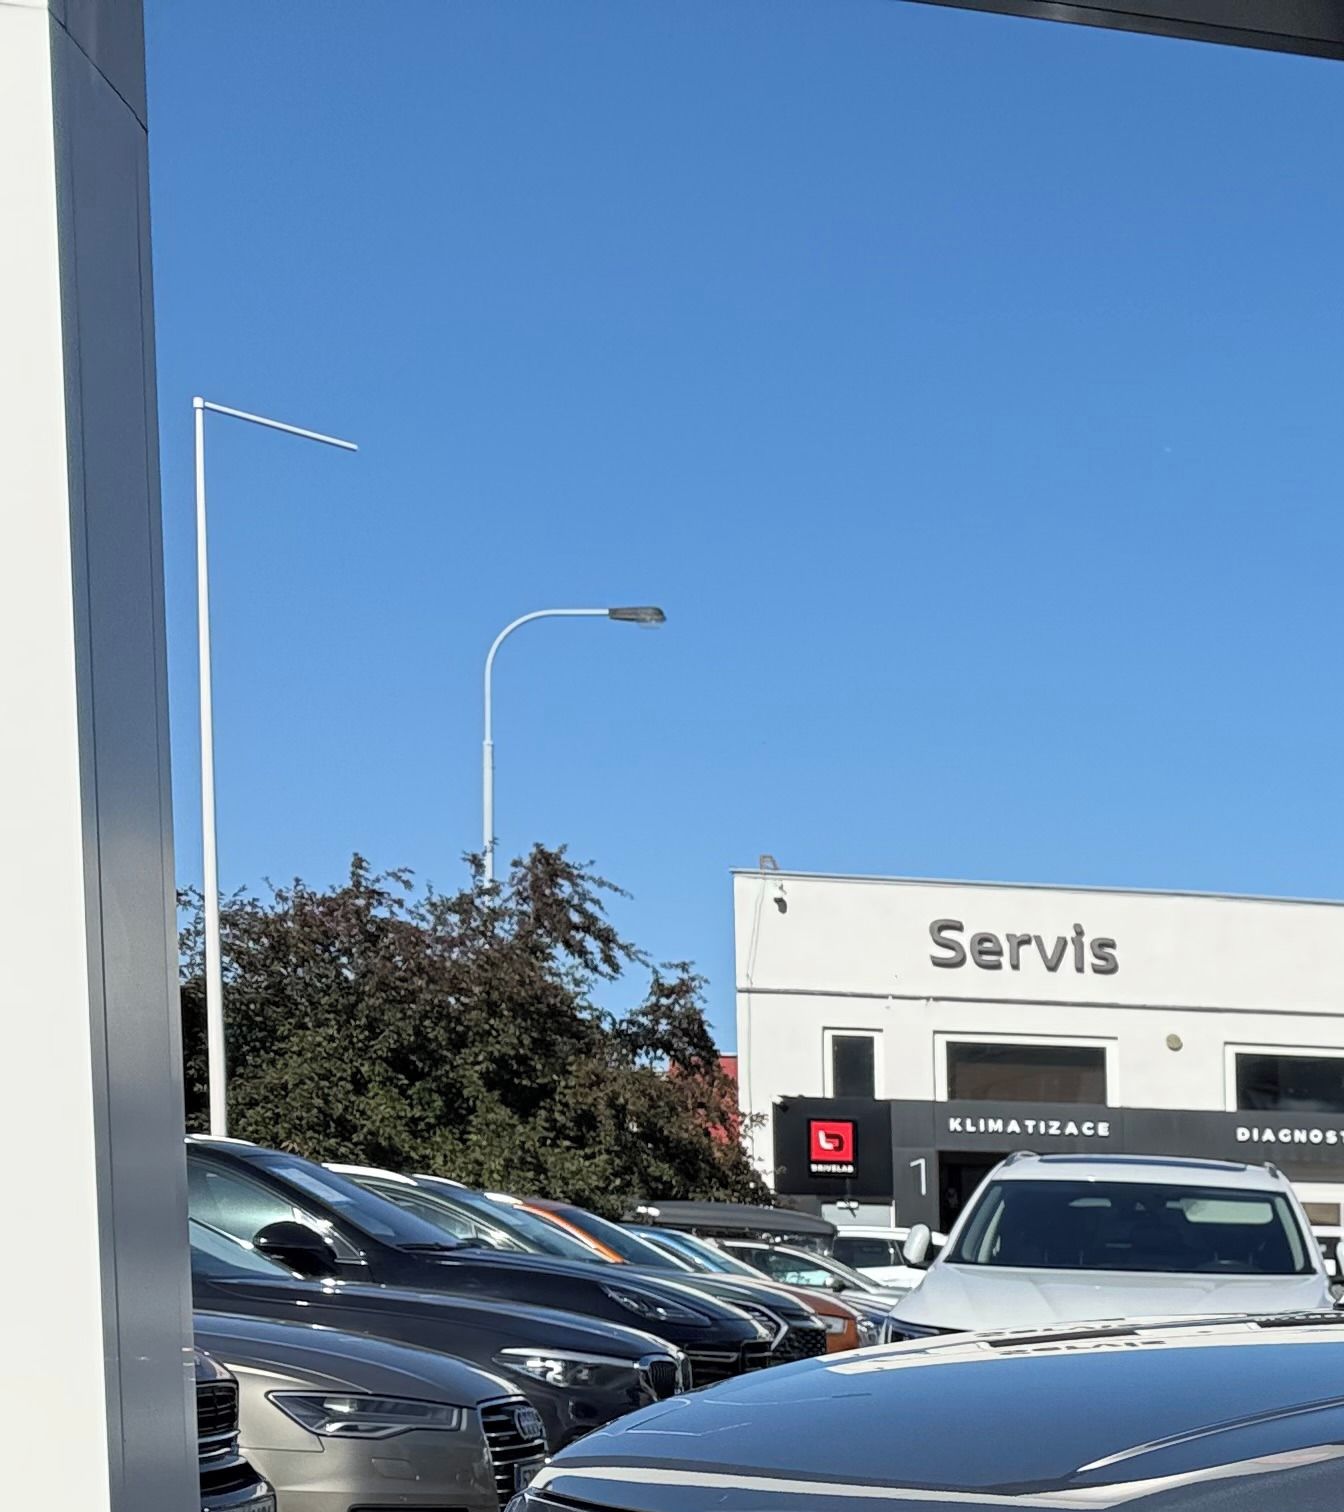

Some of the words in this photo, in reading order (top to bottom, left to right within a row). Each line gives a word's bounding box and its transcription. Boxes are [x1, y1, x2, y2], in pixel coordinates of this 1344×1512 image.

[929, 918, 1120, 976] Servis
[949, 1117, 1111, 1138] KLIMATIZACE
[909, 1157, 927, 1197] 1
